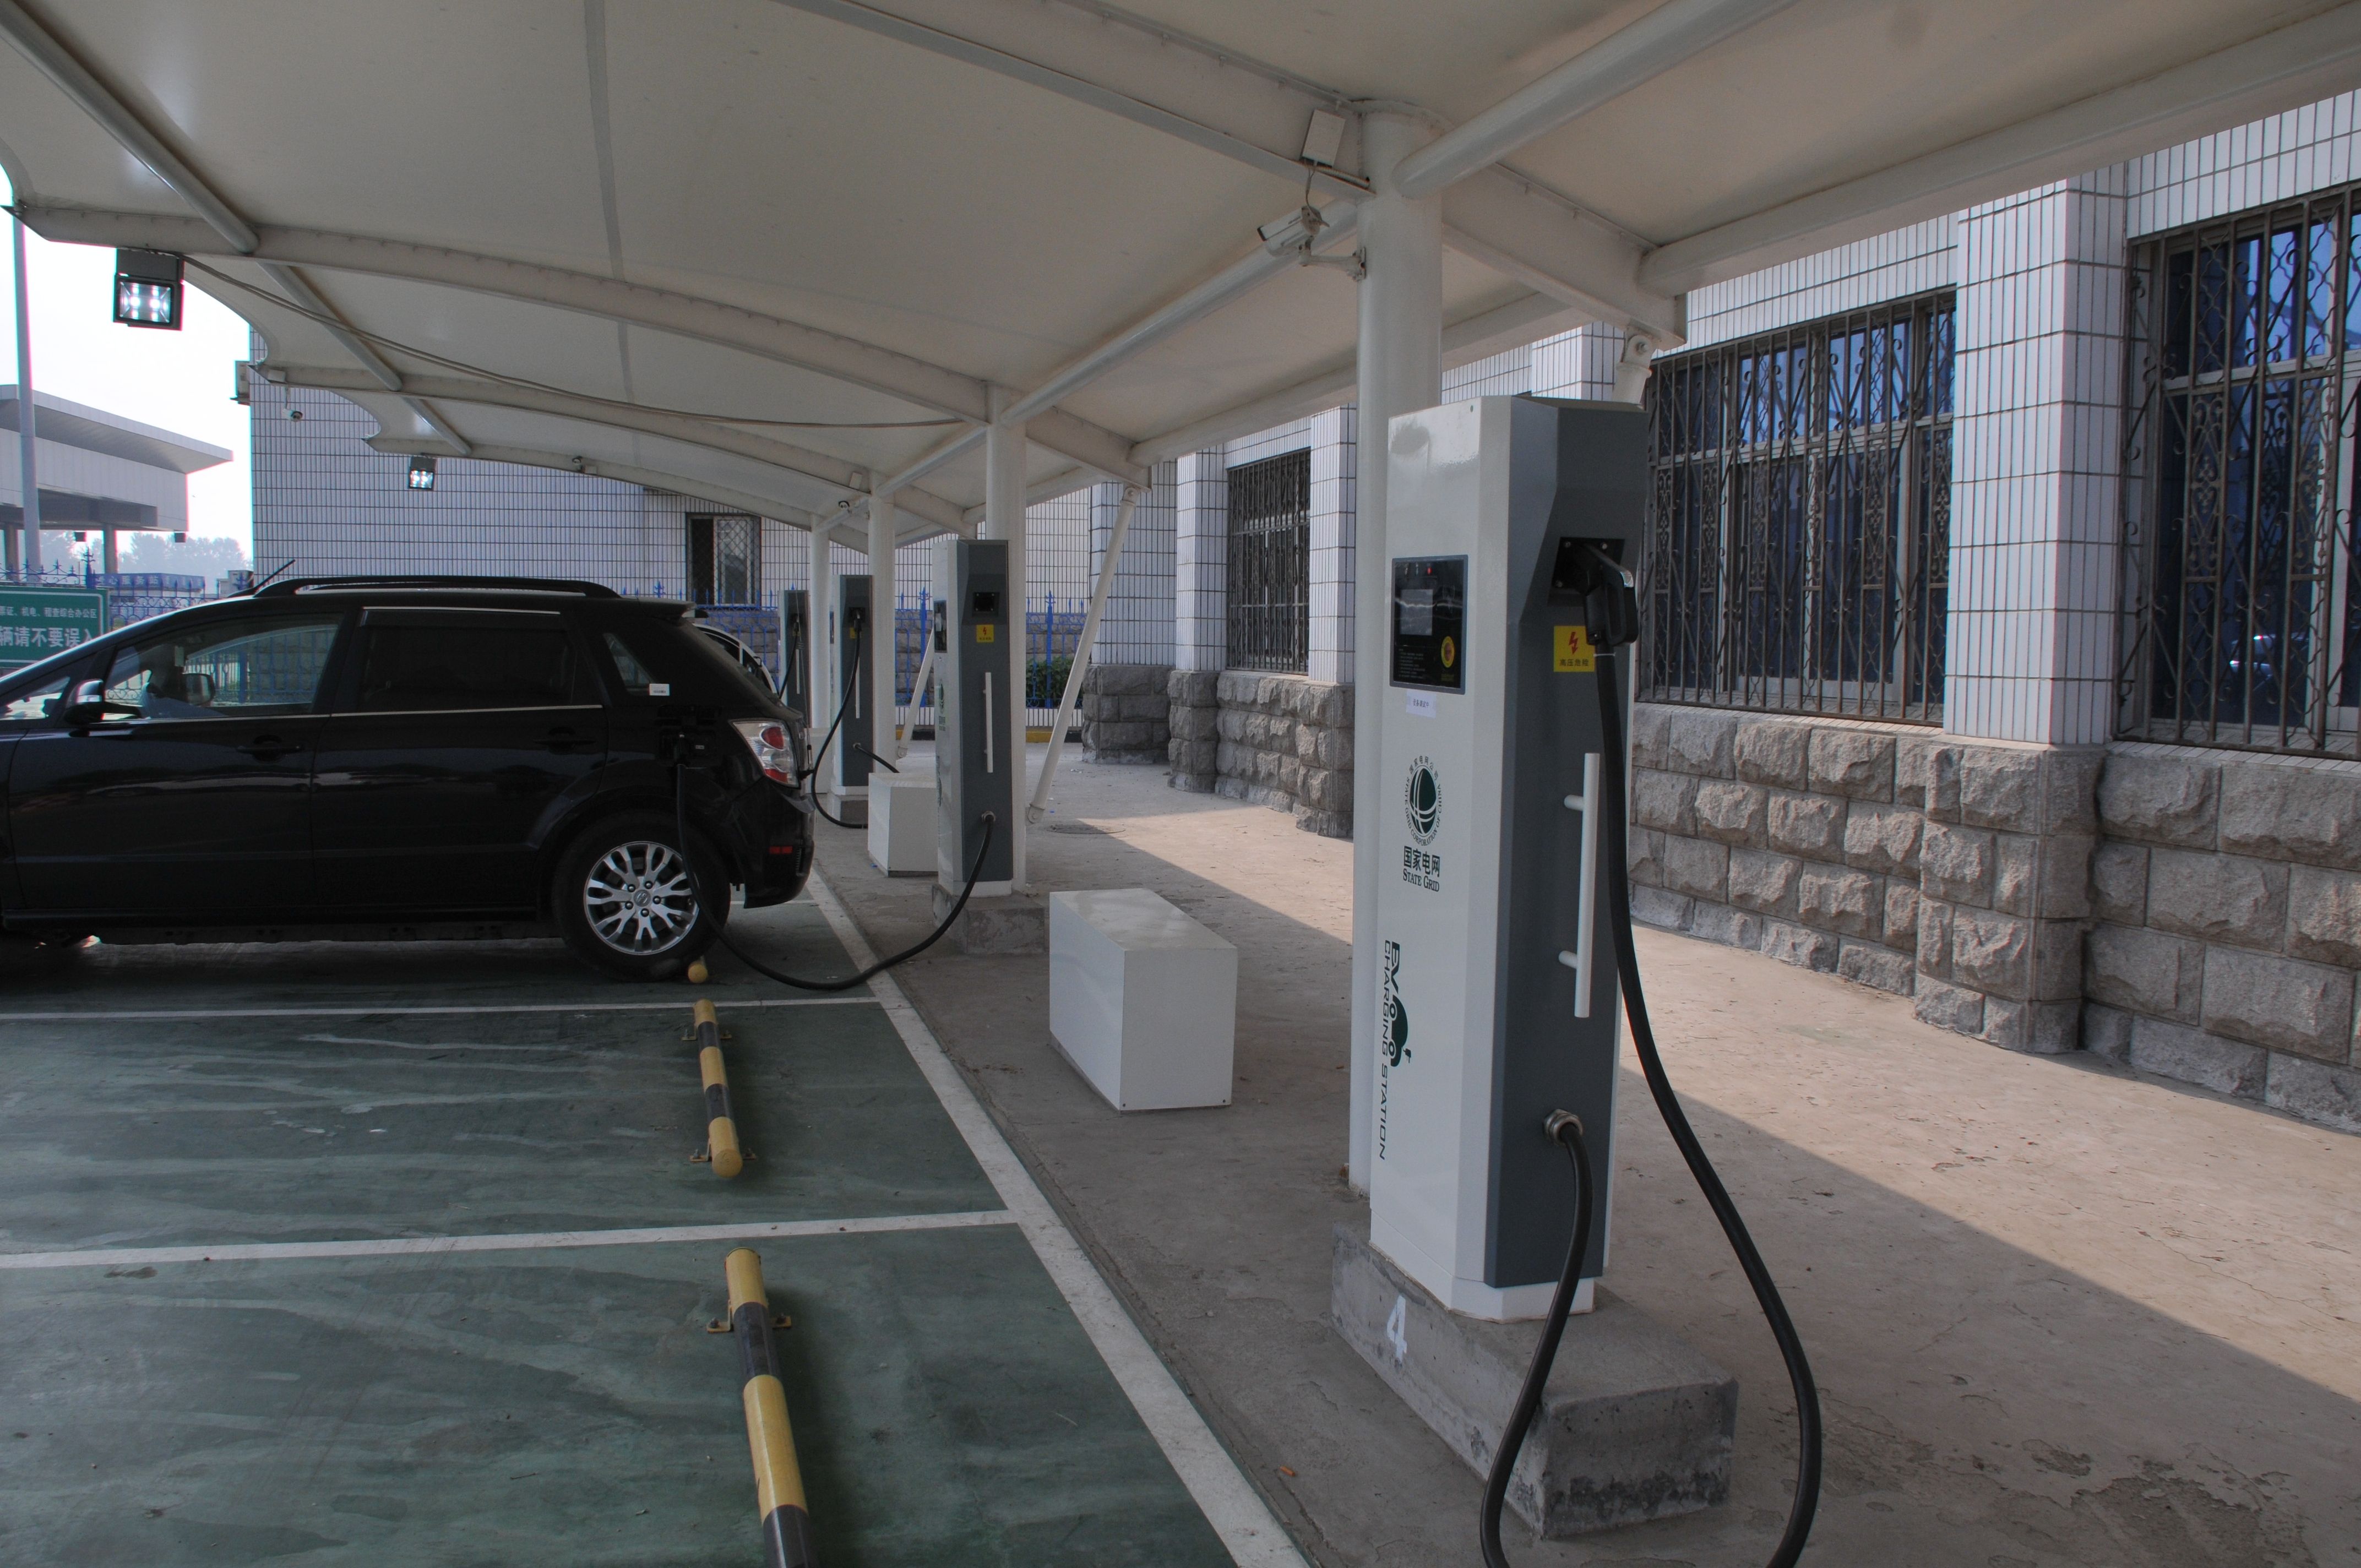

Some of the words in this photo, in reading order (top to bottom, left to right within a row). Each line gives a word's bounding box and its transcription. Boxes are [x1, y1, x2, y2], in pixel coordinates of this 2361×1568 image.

[1559, 658, 1589, 667] 高压危险
[1403, 846, 1440, 878] 国家电网
[1403, 868, 1422, 886] STATE
[1423, 876, 1440, 892] GRID
[1390, 941, 1400, 994] EV
[1381, 939, 1390, 1057] CHARGING
[1379, 1063, 1388, 1160] STATION
[1386, 1295, 1407, 1364] 4
